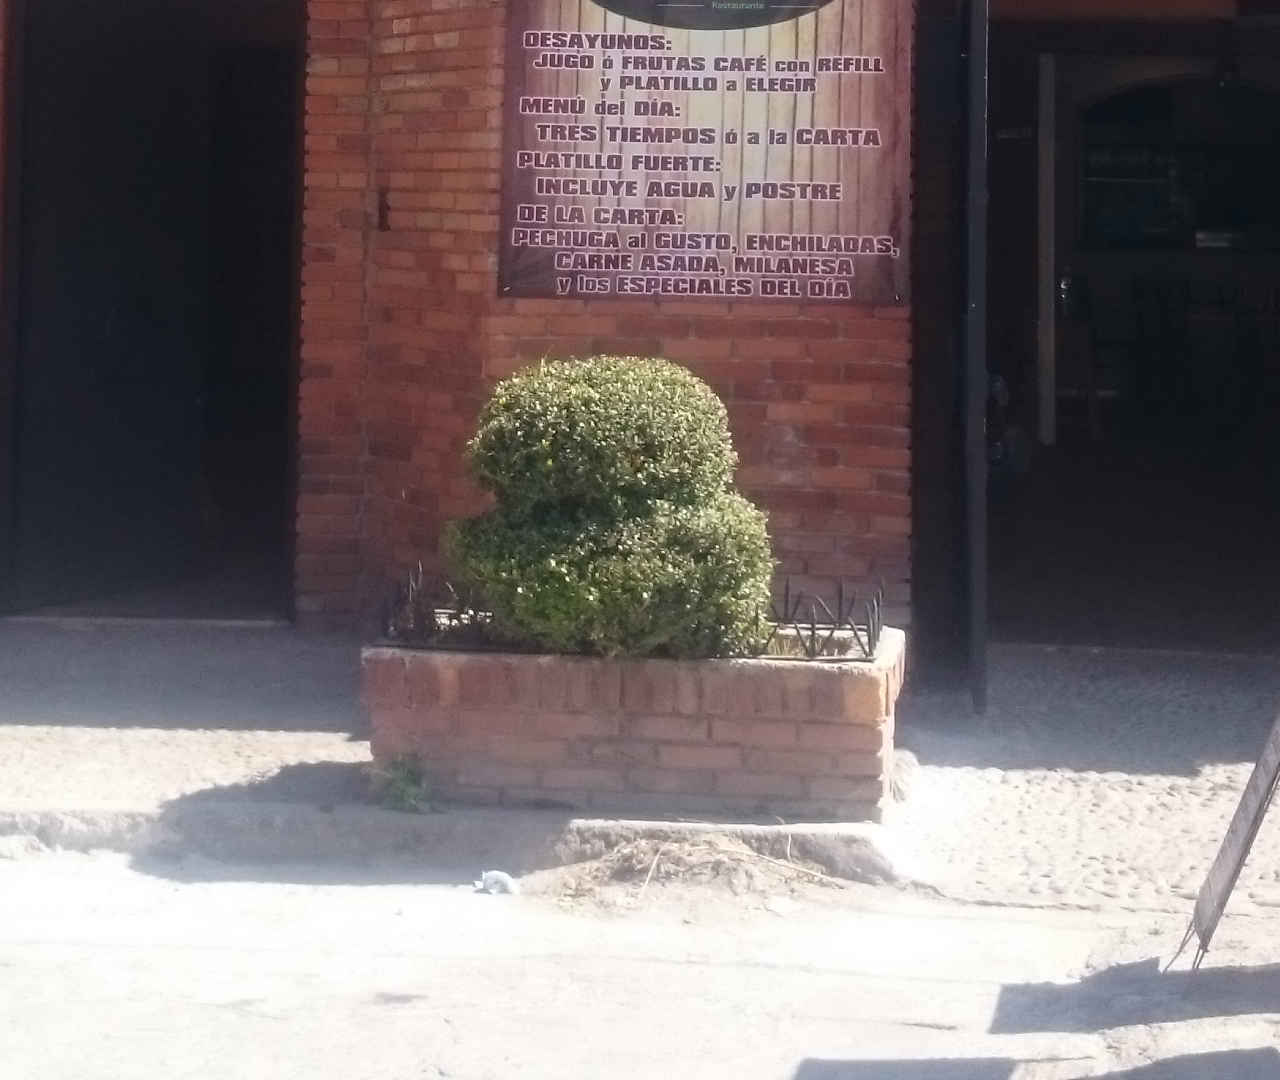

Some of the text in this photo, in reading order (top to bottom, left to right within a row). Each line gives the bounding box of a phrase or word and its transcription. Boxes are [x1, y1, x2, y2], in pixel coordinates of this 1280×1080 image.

[712, 2, 764, 10] Restaurante
[524, 32, 672, 50] DESAYUNOS:
[534, 53, 884, 72] JUGO ó FRUTAS CAFÉ con REFILL
[600, 76, 817, 92] y PLATILLO a ELEGIR
[520, 96, 681, 116] MENÚ del DÍA:
[537, 124, 881, 146] TRES TIEMPOS ó a la CARTA
[517, 151, 722, 172] PLATILLO FUERTE:
[536, 178, 842, 201] INCLUYE AGUA y POSTRE
[518, 205, 684, 225] DE LA CARTA:
[513, 228, 900, 257] PECHUGA al GUSTO, ENCHILADAS,
[556, 252, 854, 276] CARNE ASADA, MILANESA
[557, 275, 851, 297] y los ESPECIALES DEL DÍA
